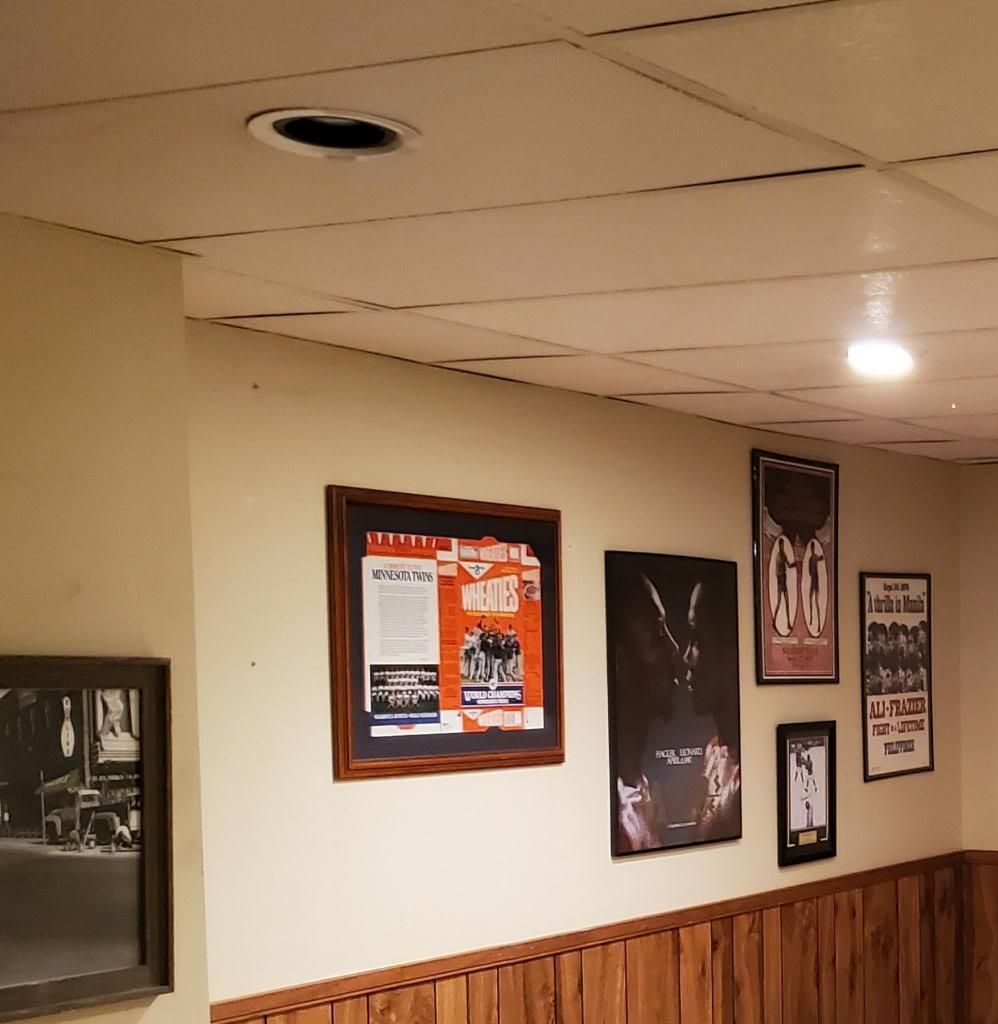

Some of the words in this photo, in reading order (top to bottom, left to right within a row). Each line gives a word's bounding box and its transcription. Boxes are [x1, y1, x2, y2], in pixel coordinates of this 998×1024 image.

[371, 568, 412, 582] MINNESOTA
[411, 570, 434, 583] TWINS
[461, 574, 520, 613] WHEATIES
